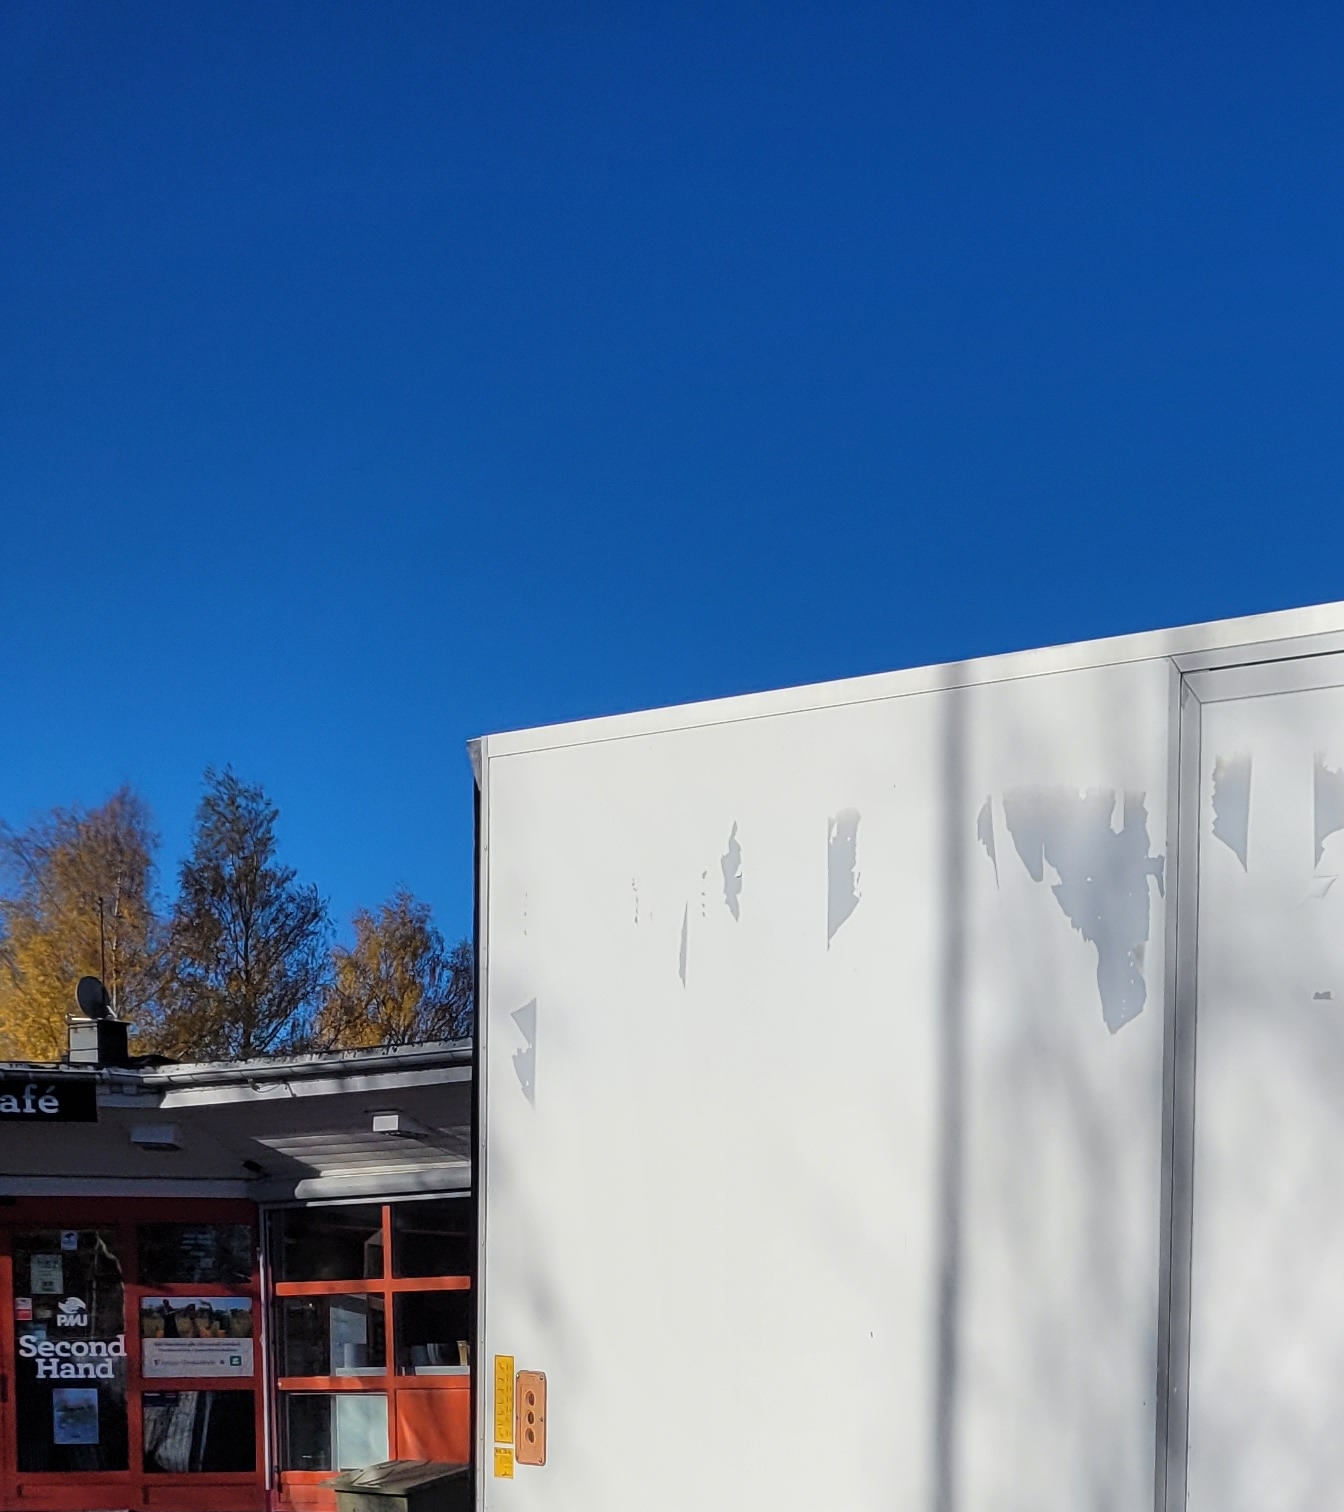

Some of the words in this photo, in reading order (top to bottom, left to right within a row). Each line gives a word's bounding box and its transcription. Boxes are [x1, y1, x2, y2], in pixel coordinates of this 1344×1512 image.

[0, 1083, 59, 1113] afé
[57, 1314, 88, 1326] PMU
[19, 1334, 127, 1357] Second
[35, 1358, 115, 1378] Hand
